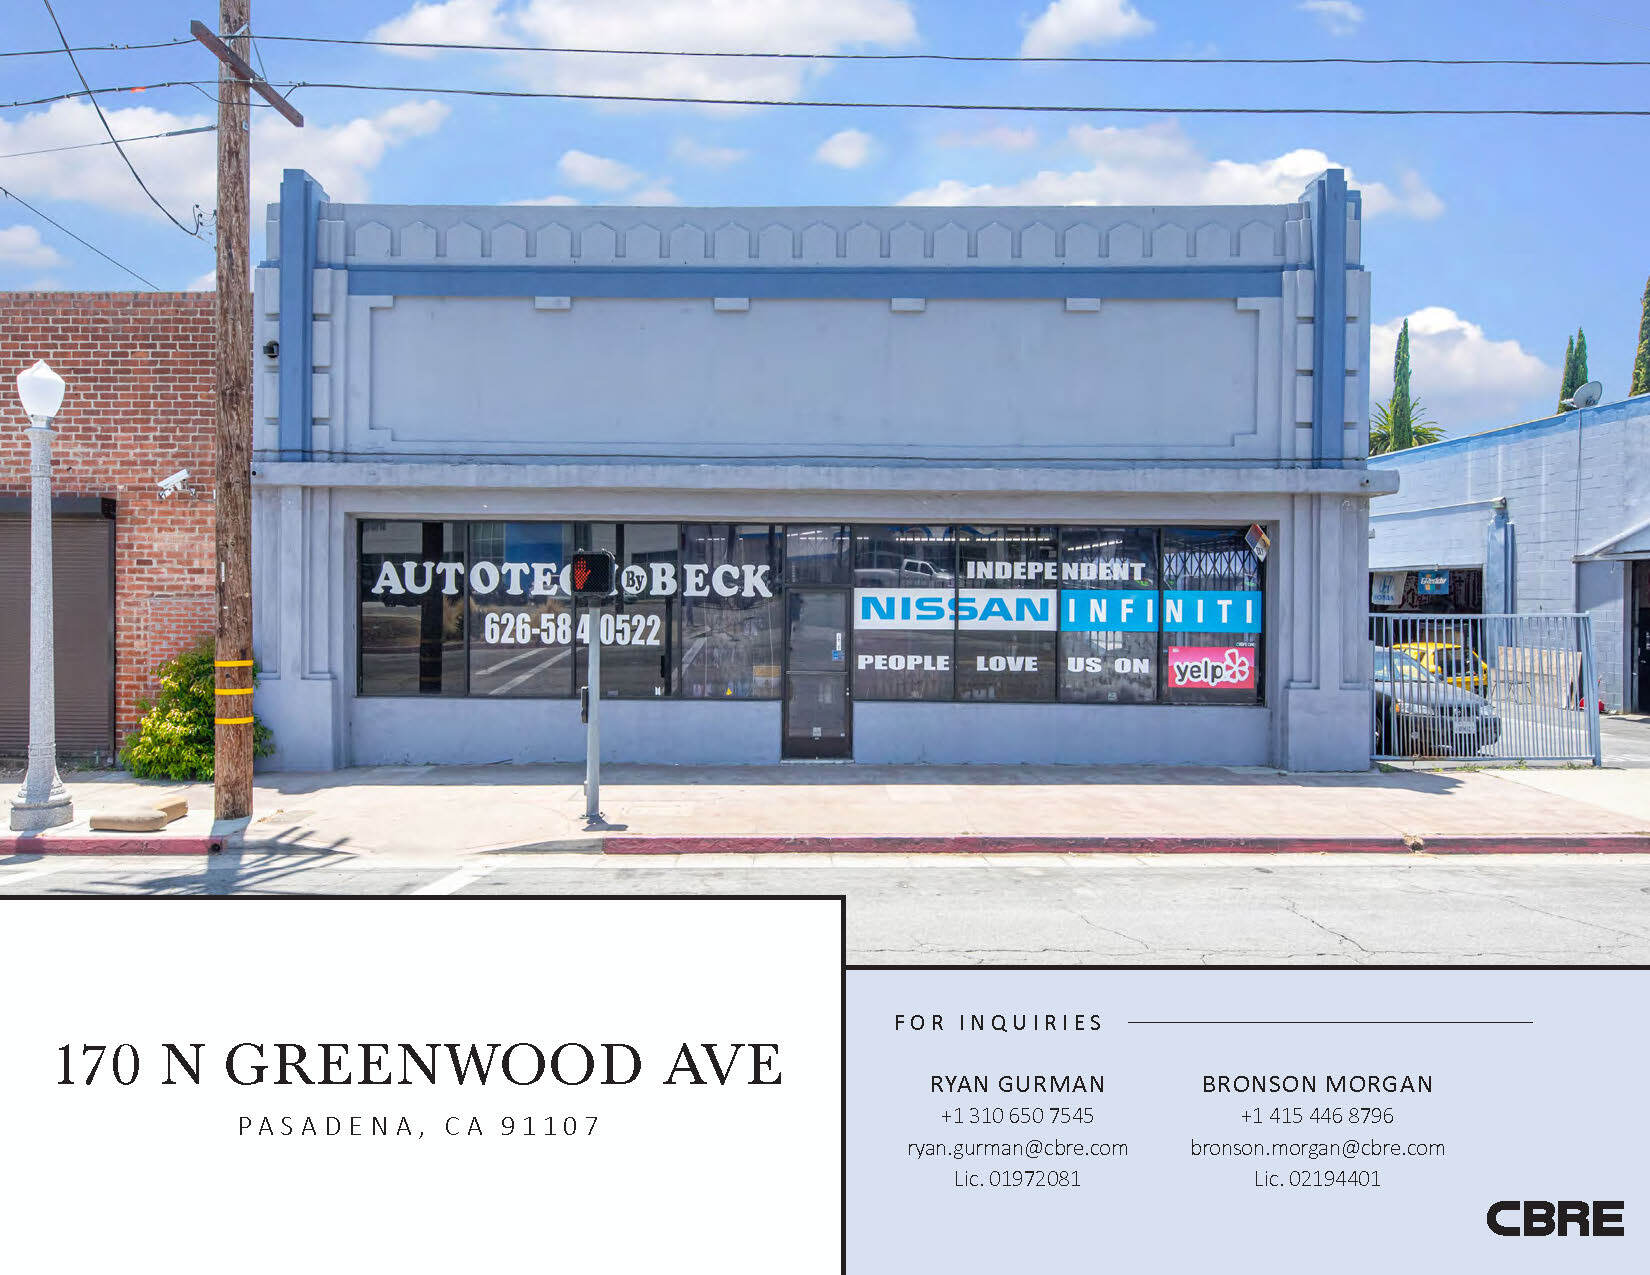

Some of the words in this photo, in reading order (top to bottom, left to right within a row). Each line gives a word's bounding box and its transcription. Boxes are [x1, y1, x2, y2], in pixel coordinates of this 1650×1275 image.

[371, 560, 619, 596] AUTOTE
[625, 570, 645, 591] By
[650, 562, 774, 598] BECK
[967, 561, 1146, 581] INDEPENDENT
[861, 596, 1049, 622] NISSAN
[1068, 598, 1253, 624] INFINITI
[484, 612, 661, 646] 626-5840522
[857, 655, 950, 671] PEOPLE
[976, 656, 1038, 672] LOVE
[1067, 657, 1102, 673] US
[1114, 658, 1150, 674] ON
[1175, 659, 1224, 684] yelp
